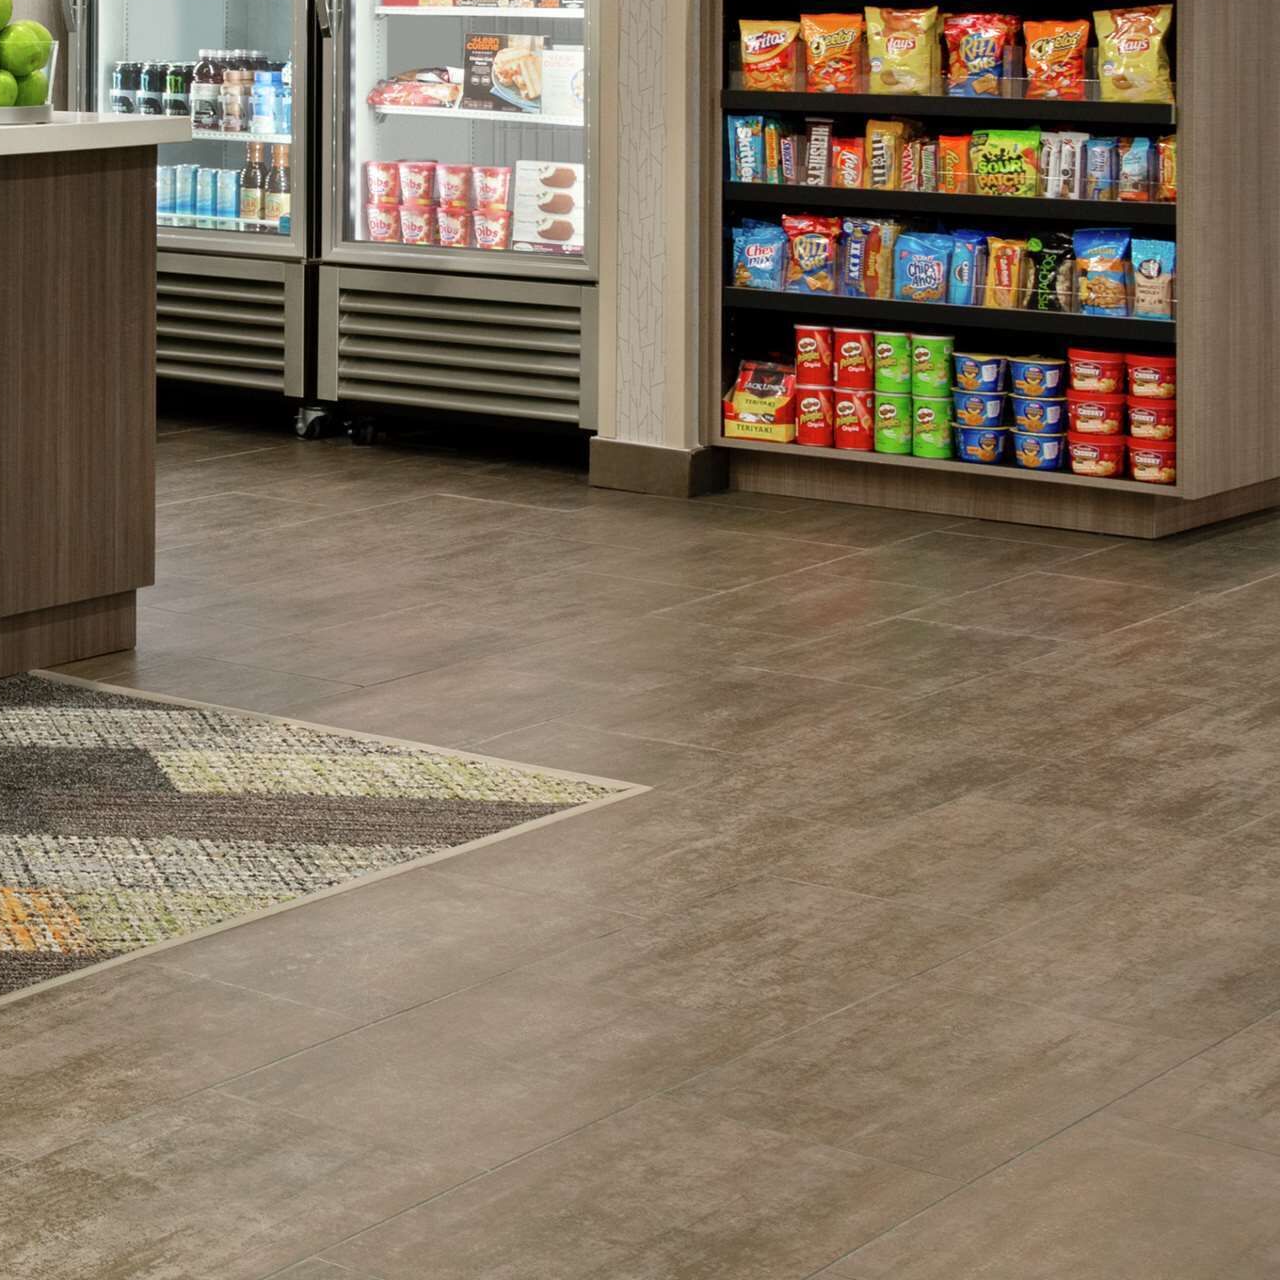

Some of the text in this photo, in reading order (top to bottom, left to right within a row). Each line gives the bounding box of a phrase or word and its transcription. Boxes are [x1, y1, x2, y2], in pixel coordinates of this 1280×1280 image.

[744, 32, 788, 53] Fritos
[978, 160, 1023, 174] SOUR
[978, 172, 1025, 188] PATCH
[736, 423, 773, 433] TERIYAKI
